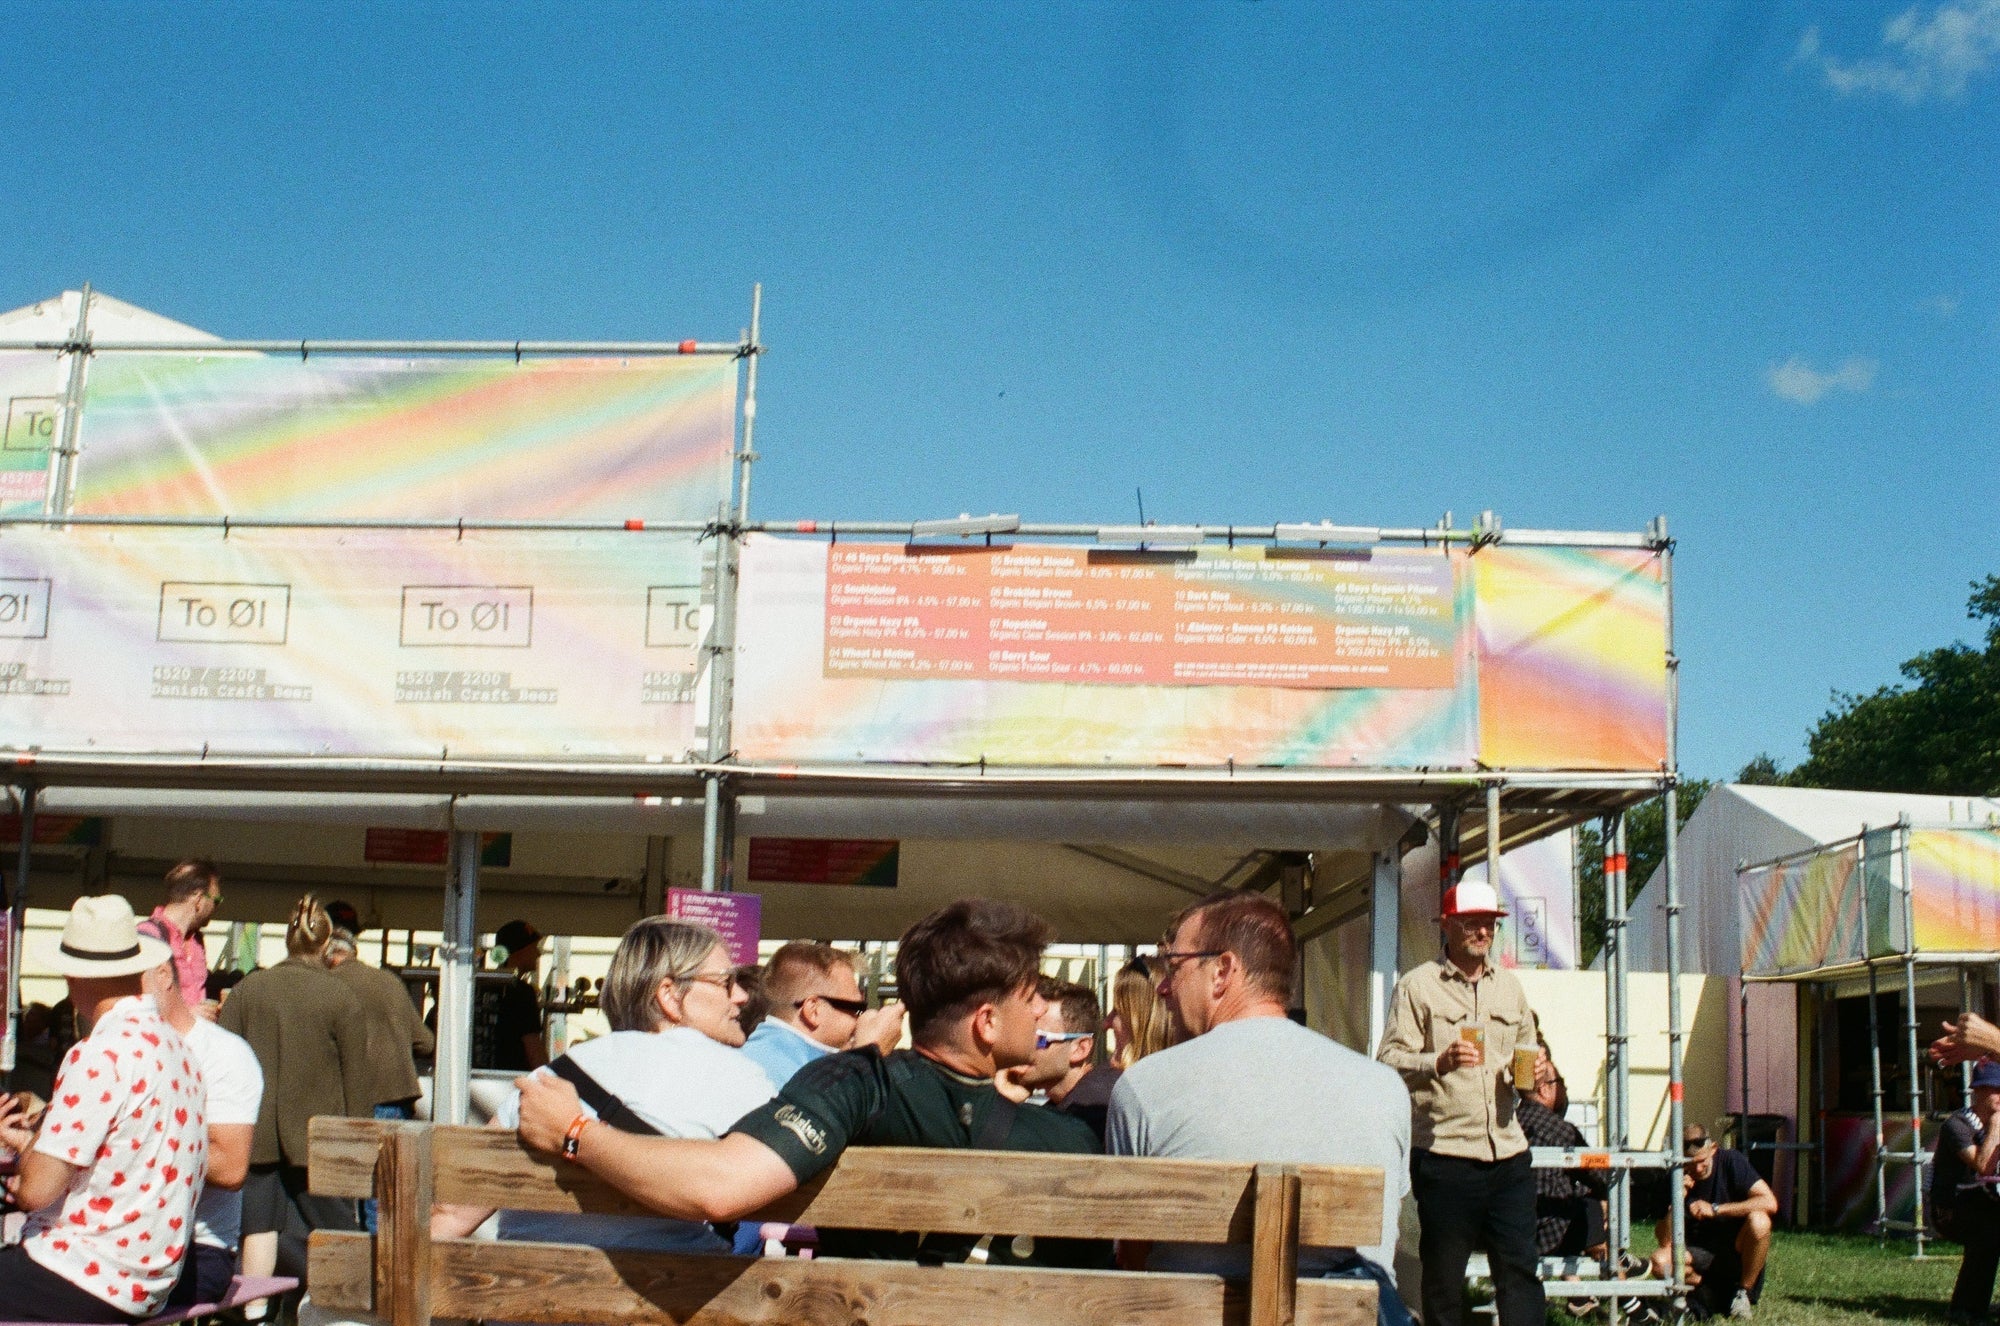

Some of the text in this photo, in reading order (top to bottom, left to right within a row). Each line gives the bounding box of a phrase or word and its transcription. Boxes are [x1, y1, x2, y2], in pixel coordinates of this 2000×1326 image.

[24, 411, 53, 436] To
[831, 584, 842, 594] 02
[179, 598, 266, 628] To Øl
[420, 602, 509, 631] To Øl
[666, 602, 700, 631] To
[904, 617, 919, 627] IPA
[154, 666, 191, 681] 4520
[219, 668, 257, 682] 2200
[397, 671, 434, 685] 4520
[462, 672, 500, 686] 2200
[643, 672, 681, 686] 4520
[152, 684, 209, 697] Danish
[216, 685, 266, 698] Craft
[395, 687, 451, 701] Danish
[461, 688, 510, 701] Craft
